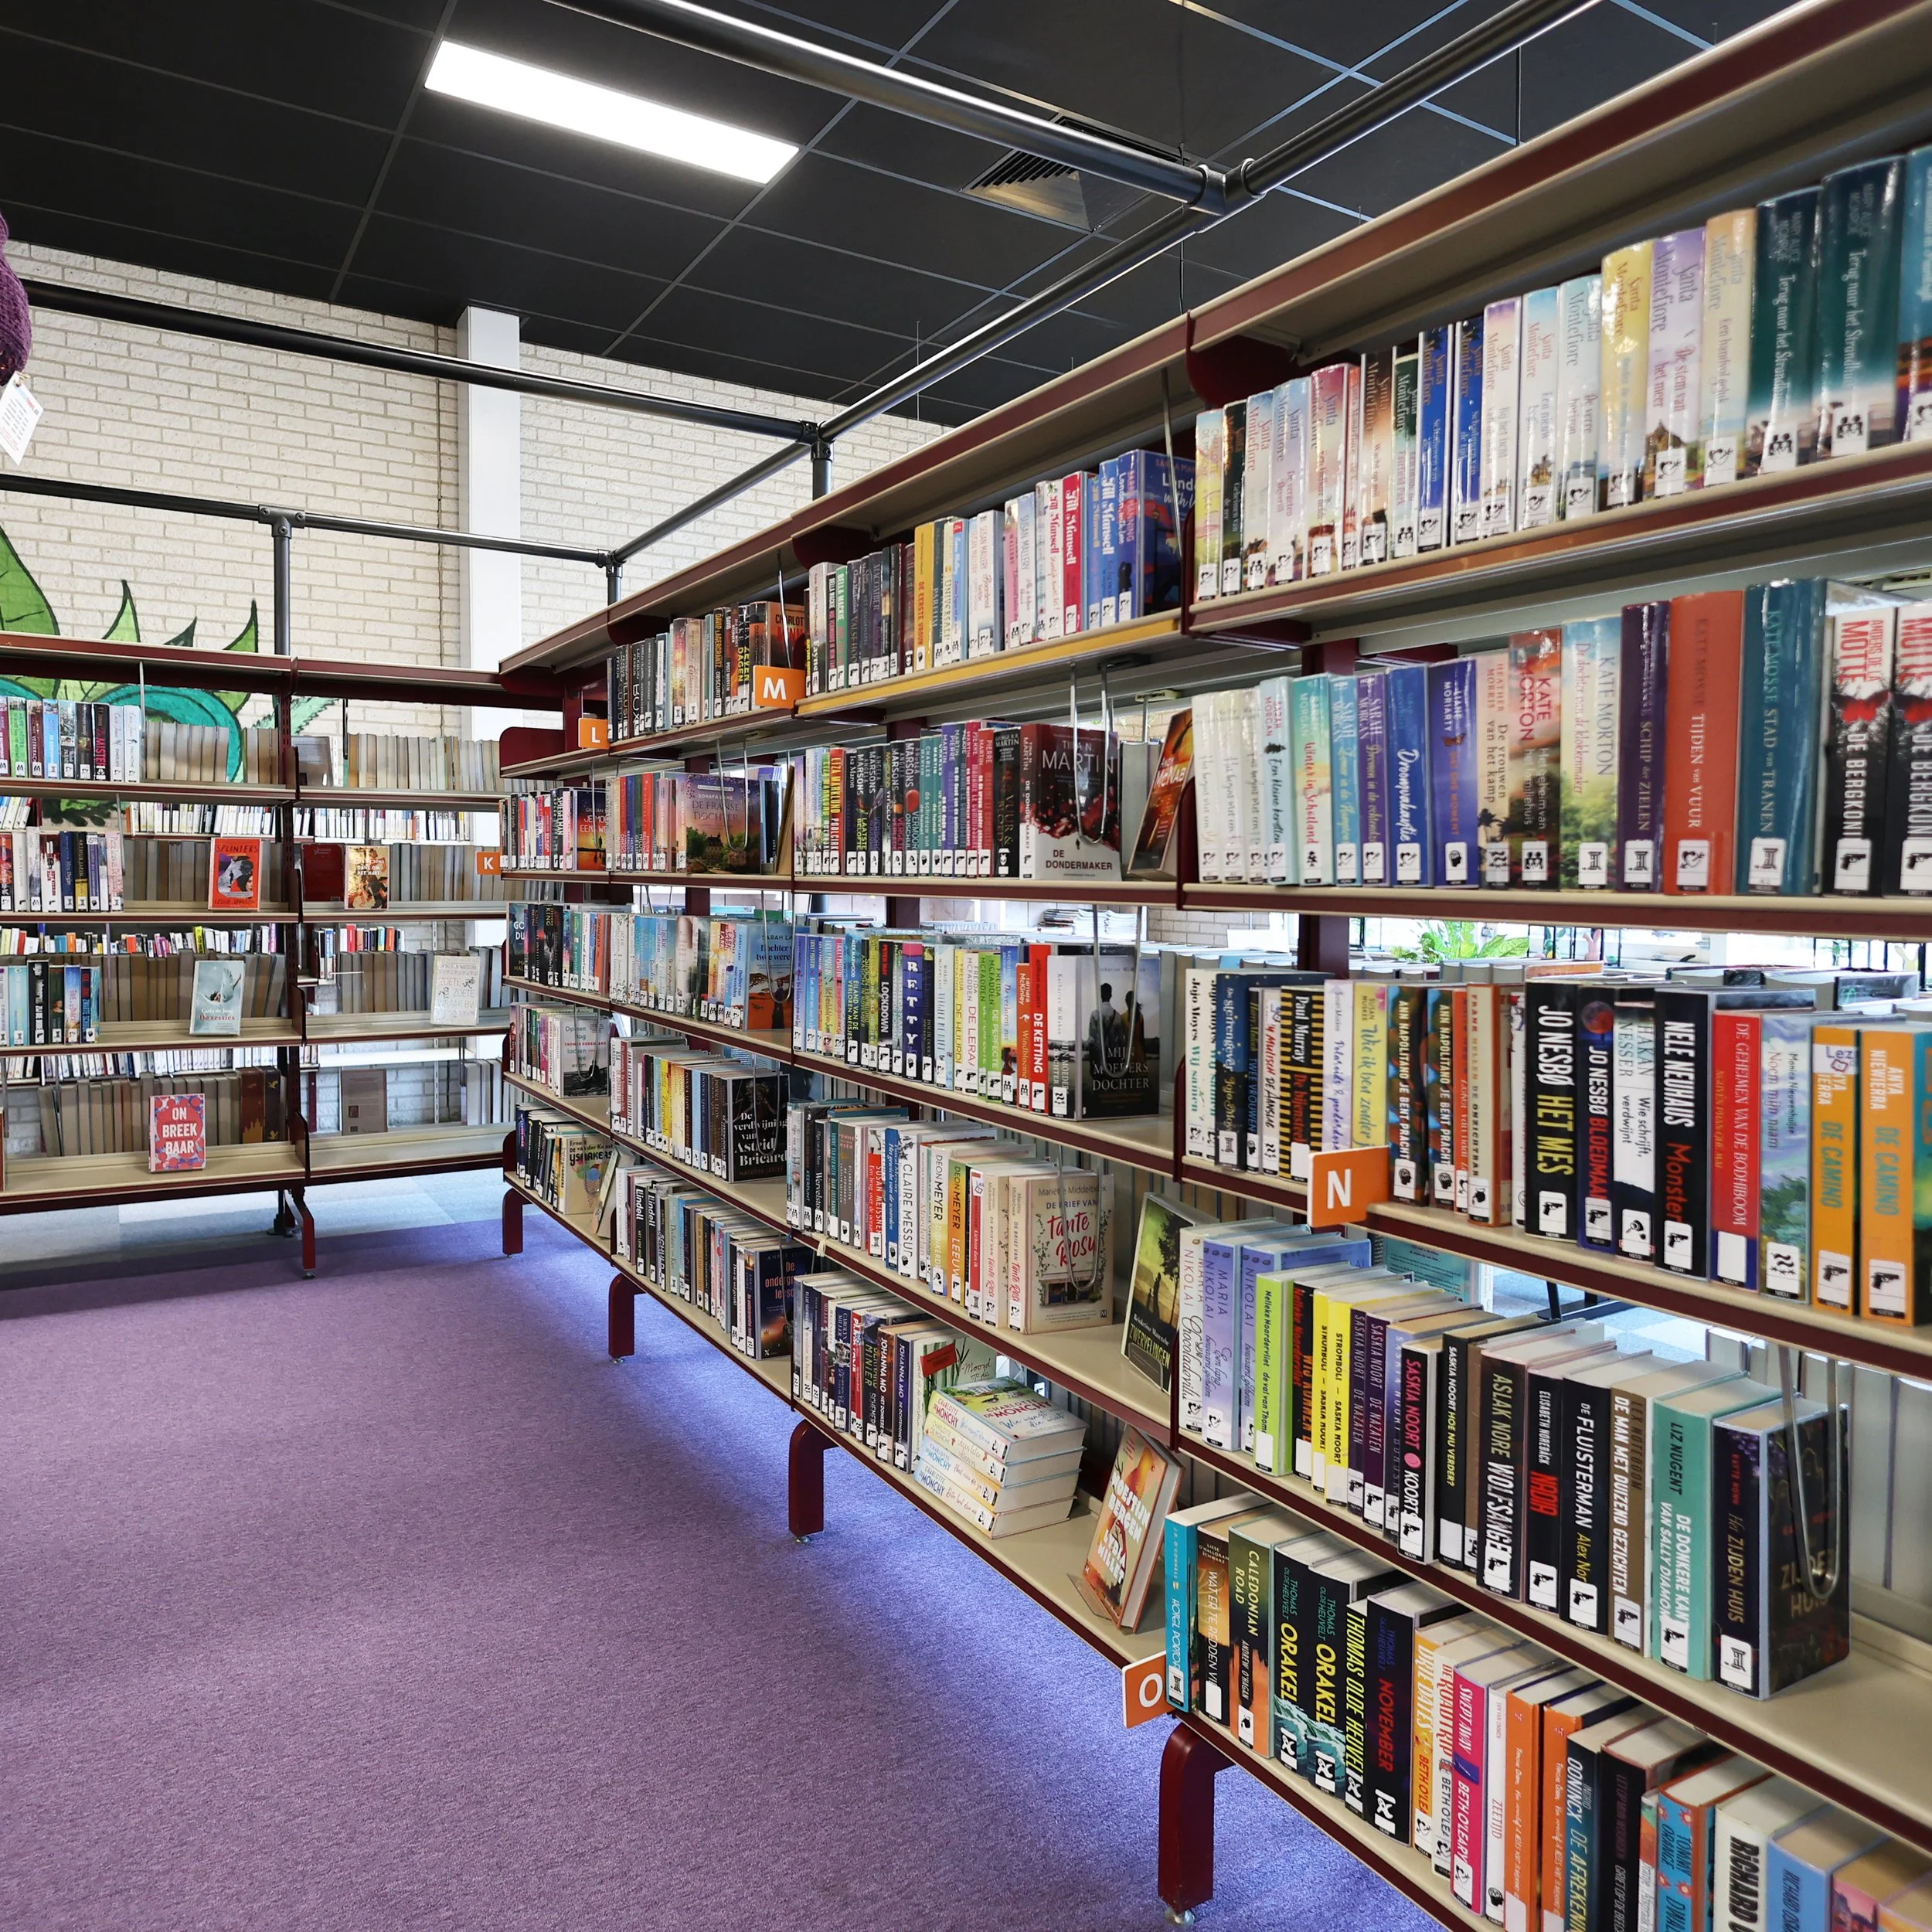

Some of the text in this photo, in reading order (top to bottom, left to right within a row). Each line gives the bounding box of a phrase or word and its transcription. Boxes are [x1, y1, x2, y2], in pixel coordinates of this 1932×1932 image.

[1673, 264, 1699, 303] Santa
[1839, 621, 1869, 683] MOTTE
[763, 678, 786, 699] M
[1444, 682, 1452, 732] MORIARTY
[591, 728, 600, 743] L
[1488, 747, 1498, 767] het
[1640, 720, 1652, 763] SCHIP
[1690, 713, 1706, 764] TIJDEN
[1847, 733, 1868, 752] DE
[906, 743, 914, 787] MARSONS
[1498, 745, 1506, 798] vrouwen
[1485, 772, 1496, 803] kamp
[1638, 781, 1651, 832] ZIELEN
[1688, 785, 1704, 828] VUUR
[485, 859, 494, 869] K
[1046, 860, 1113, 870] DONDERMAKER
[1053, 849, 1065, 858] DE
[968, 1006, 976, 1022] DE
[1189, 978, 1201, 1041] Jojo Moyes
[1292, 995, 1309, 1063] Paul Murray
[1537, 1005, 1573, 1028] JO
[1033, 1013, 1043, 1073] DE KETTING
[1398, 1000, 1410, 1121] ANN NAPOLITANO BENT
[1588, 1045, 1609, 1065] JO
[1618, 1021, 1634, 1077] NESSER
[1092, 1078, 1149, 1091] DOCHTER
[1664, 1021, 1696, 1128] NELE NEUHAUS
[1733, 1022, 1750, 1130] DE GEHEIMEN VAN
[1887, 1066, 1904, 1095] ANYA
[172, 1107, 187, 1120] ON
[1622, 1095, 1632, 1144] verdwijnt
[1638, 1097, 1651, 1118] Wie
[162, 1124, 197, 1138] BREEK
[165, 1141, 195, 1154] BAAR
[1537, 1094, 1575, 1176] HET MES
[903, 1164, 913, 1207] CLAIRE
[1820, 1121, 1844, 1209] DE CAMINO
[1873, 1126, 1900, 1216] DE CAMINO
[934, 1182, 943, 1221] MEYER
[1327, 1168, 1351, 1208] N
[786, 1262, 794, 1272] De
[1184, 1249, 1193, 1307] NIKOLAI
[1205, 1260, 1214, 1318] NIKOLAI
[1218, 1269, 1228, 1315] MARIA
[879, 1338, 888, 1392] JOHANNA MO
[1406, 1359, 1421, 1402] SASKIA
[898, 1382, 904, 1398] MO
[986, 1398, 1037, 1413] CHARLOTTE
[994, 1401, 1052, 1419] MONCHY
[1369, 1324, 1383, 1454] SASKIA NOORT NAZATEN
[1539, 1391, 1551, 1429] ELISABETH
[935, 1406, 959, 1427] MONCHY
[1404, 1404, 1420, 1451] NOORT
[1447, 1345, 1458, 1487] SASKIA NOORT HOE VERDER?
[1490, 1373, 1514, 1459] ASLAK NORE
[1669, 1422, 1683, 1495] LIZ NUGENT
[922, 1471, 945, 1496] MONCHY
[1575, 1403, 1594, 1559] DE FLUISTERMAN Alex
[1612, 1396, 1629, 1595] DE MAN MET DUIZEND GEZICHTEN
[1660, 1501, 1672, 1566] VAN SALLY
[1675, 1514, 1692, 1592] DE DONKERE
[1235, 1566, 1245, 1604] ROAD
[1248, 1550, 1259, 1637] CALEDONIAN
[1290, 1579, 1298, 1616] THOMAS
[1726, 1535, 1744, 1623] ZIJDEN HUIS
[1281, 1587, 1290, 1621] HEUVELT
[1327, 1599, 1335, 1636] THOMAS
[1241, 1639, 1250, 1668] ANDREW
[1281, 1623, 1298, 1702] ORAKEL
[1346, 1613, 1365, 1719] THOMAS OLDE
[1139, 1673, 1163, 1708] O
[1315, 1644, 1336, 1725] ORAKEL
[1379, 1679, 1393, 1773] NOVEMBER
[1458, 1685, 1473, 1754] SWEPT AWAY
[1420, 1754, 1429, 1783] BETH
[1567, 1757, 1583, 1823] OONINCX
[1458, 1781, 1469, 1813] BETH
[1492, 1799, 1502, 1839] ZEETIJD
[1570, 1828, 1588, 1854] DE
[1662, 1824, 1675, 1869] ORANGE
